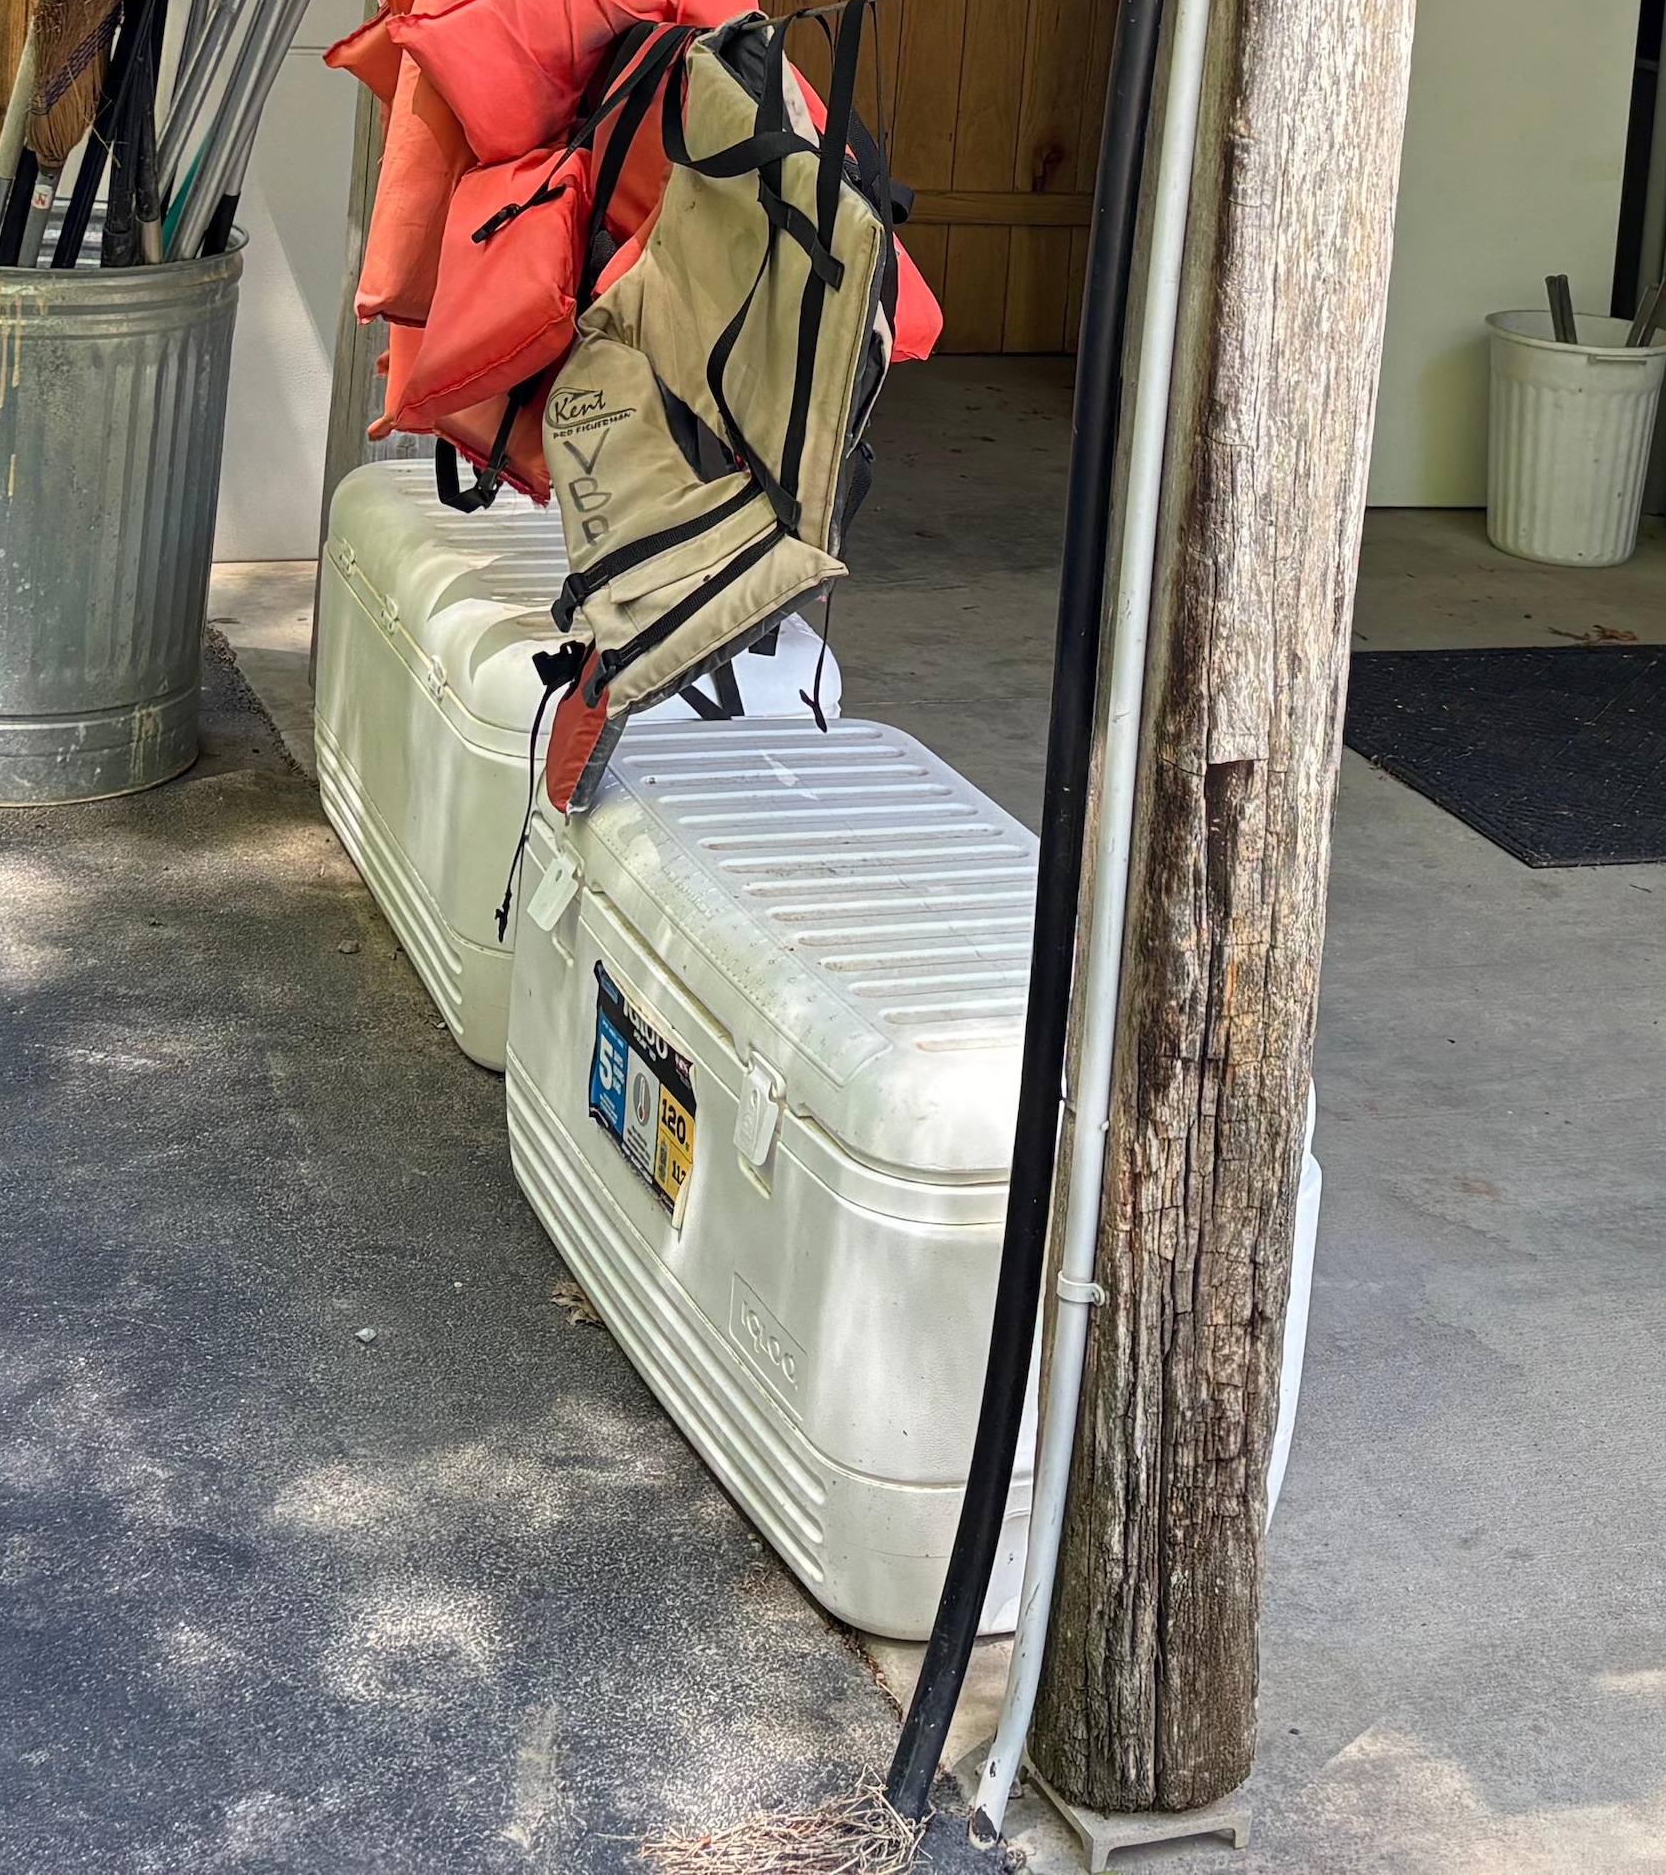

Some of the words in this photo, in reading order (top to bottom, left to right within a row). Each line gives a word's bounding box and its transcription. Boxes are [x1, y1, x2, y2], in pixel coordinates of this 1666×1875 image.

[554, 388, 607, 424] Kent
[598, 1032, 614, 1091] 5
[661, 1097, 687, 1146] 120
